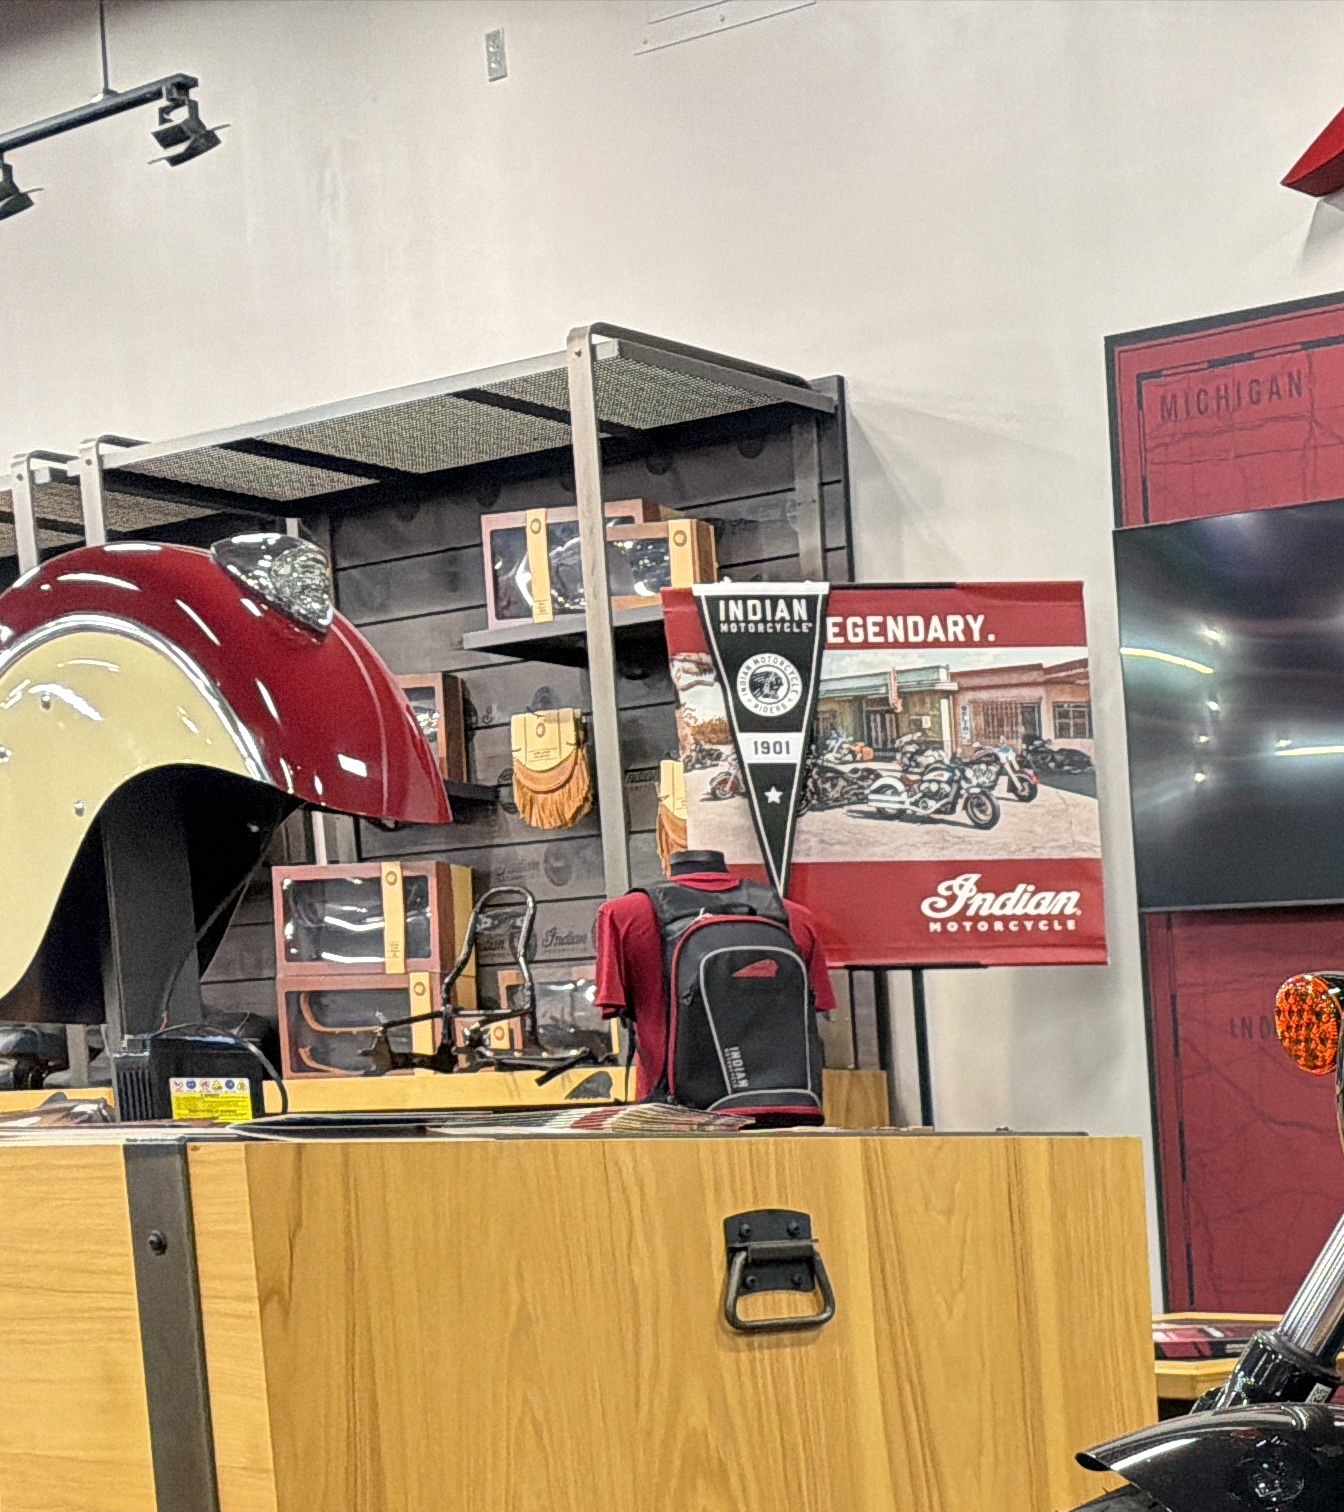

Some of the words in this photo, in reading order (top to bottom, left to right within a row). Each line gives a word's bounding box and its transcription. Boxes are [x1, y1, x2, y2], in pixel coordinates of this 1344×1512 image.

[1158, 368, 1305, 424] MICHIGAN
[719, 598, 808, 622] INDIAN
[719, 623, 812, 634] MOTORCYCLE
[826, 614, 996, 644] EGENDARY.
[753, 740, 791, 757] 1901
[929, 920, 1077, 932] MOTORCYCLE
